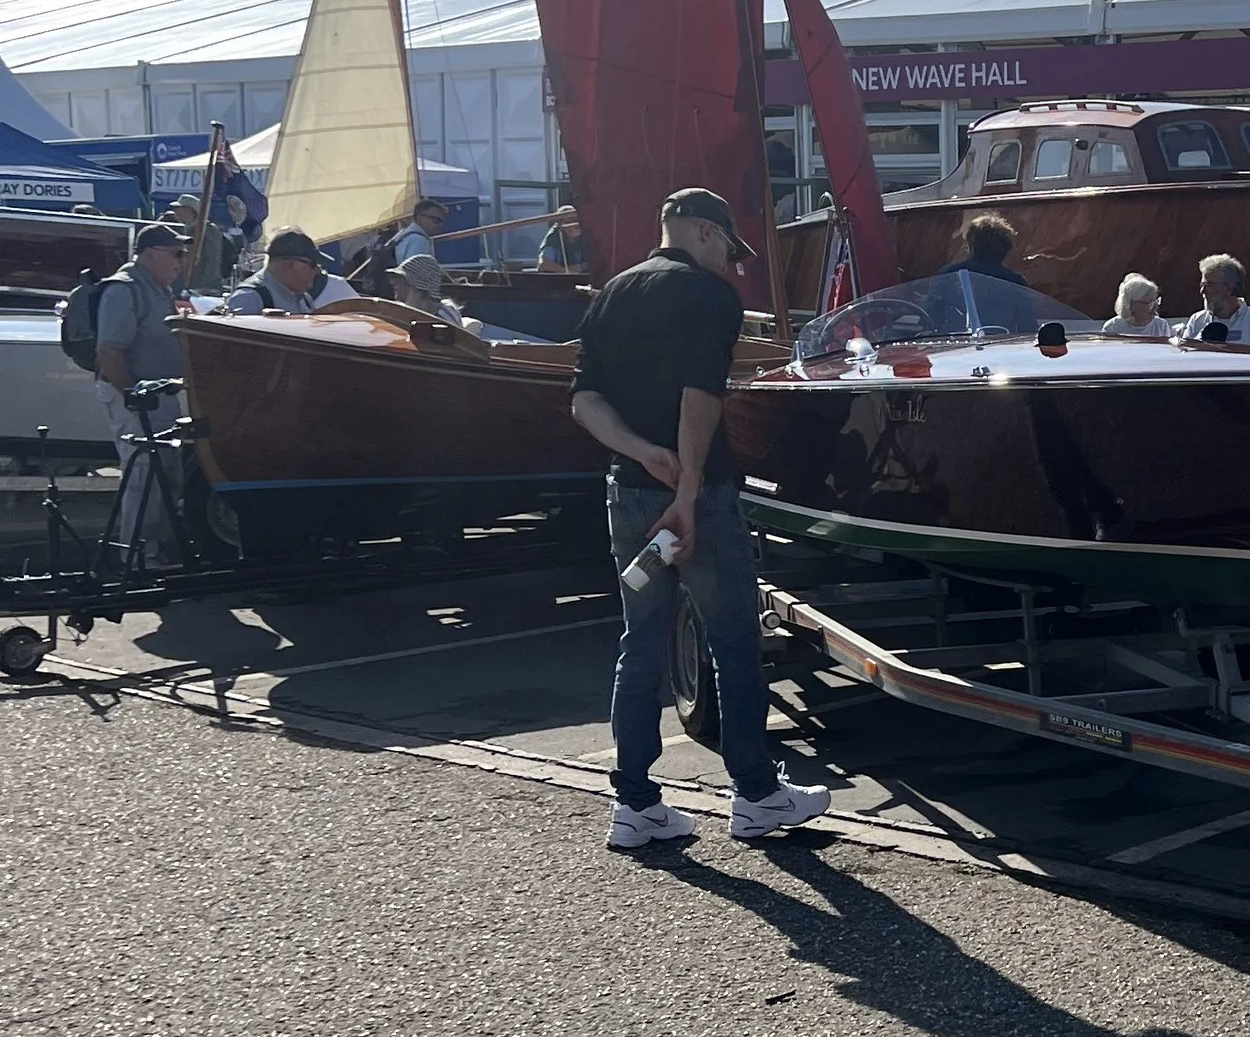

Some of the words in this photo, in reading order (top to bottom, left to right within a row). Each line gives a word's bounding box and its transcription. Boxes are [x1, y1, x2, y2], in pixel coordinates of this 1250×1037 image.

[852, 67, 900, 90] NEW
[905, 64, 966, 89] WAVE
[971, 61, 1028, 86] HALL
[0, 183, 19, 195] AY
[24, 184, 72, 197] DORIES
[1049, 714, 1069, 724] SBS
